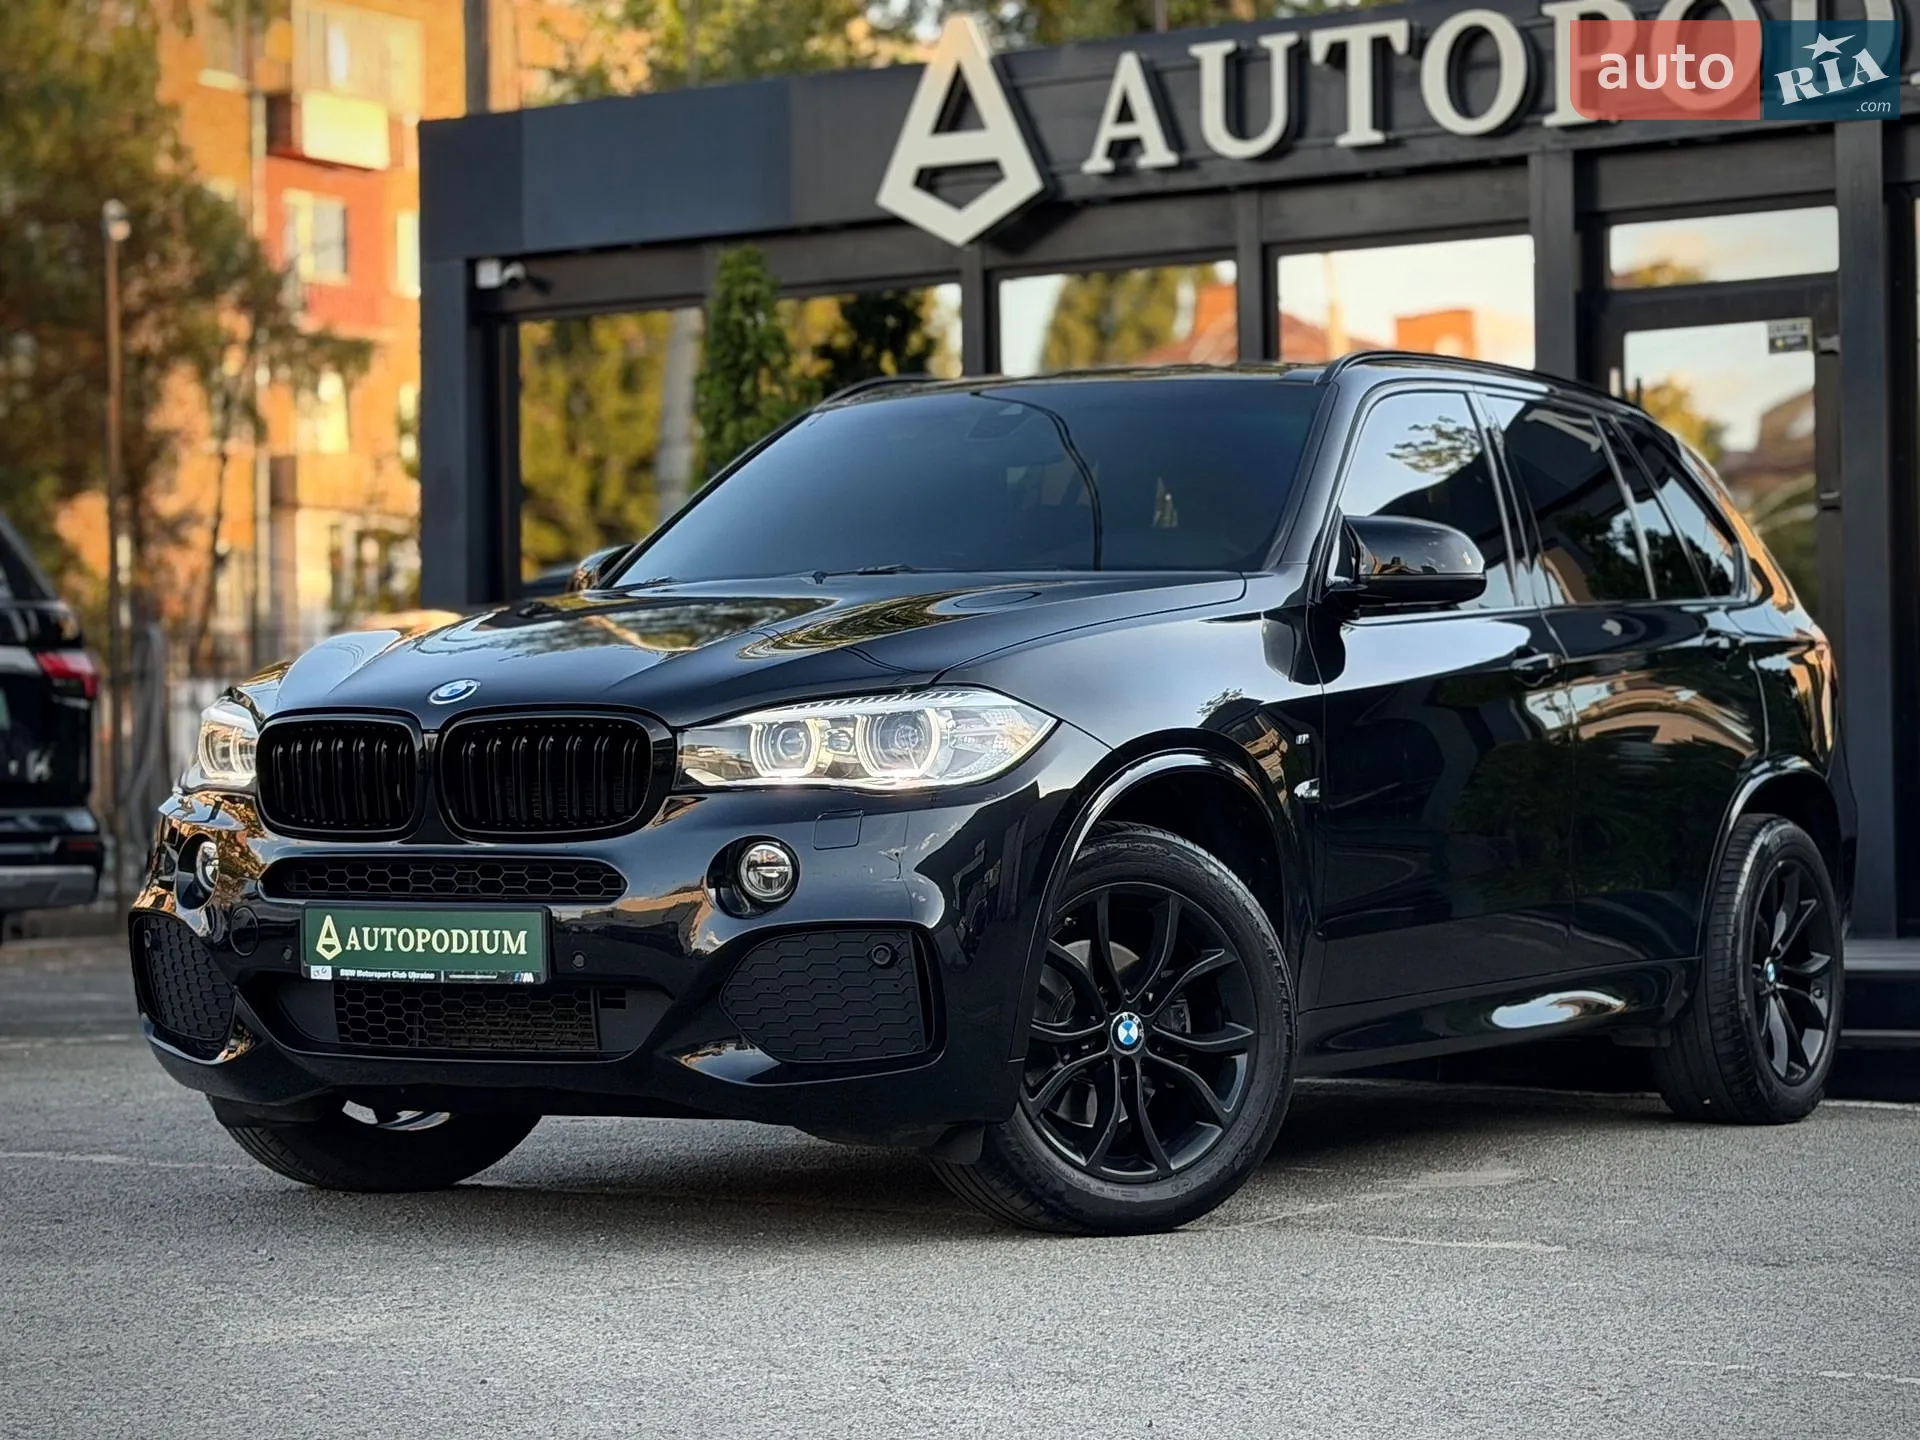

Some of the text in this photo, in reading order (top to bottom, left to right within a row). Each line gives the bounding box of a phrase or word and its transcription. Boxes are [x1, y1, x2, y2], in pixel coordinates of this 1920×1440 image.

[1081, 0, 1920, 173] AUTOPOD
[346, 927, 528, 955] AUTOPODIUM
[357, 969, 391, 979] Motorsport
[392, 970, 408, 979] Club
[408, 971, 435, 980] Ukraine
